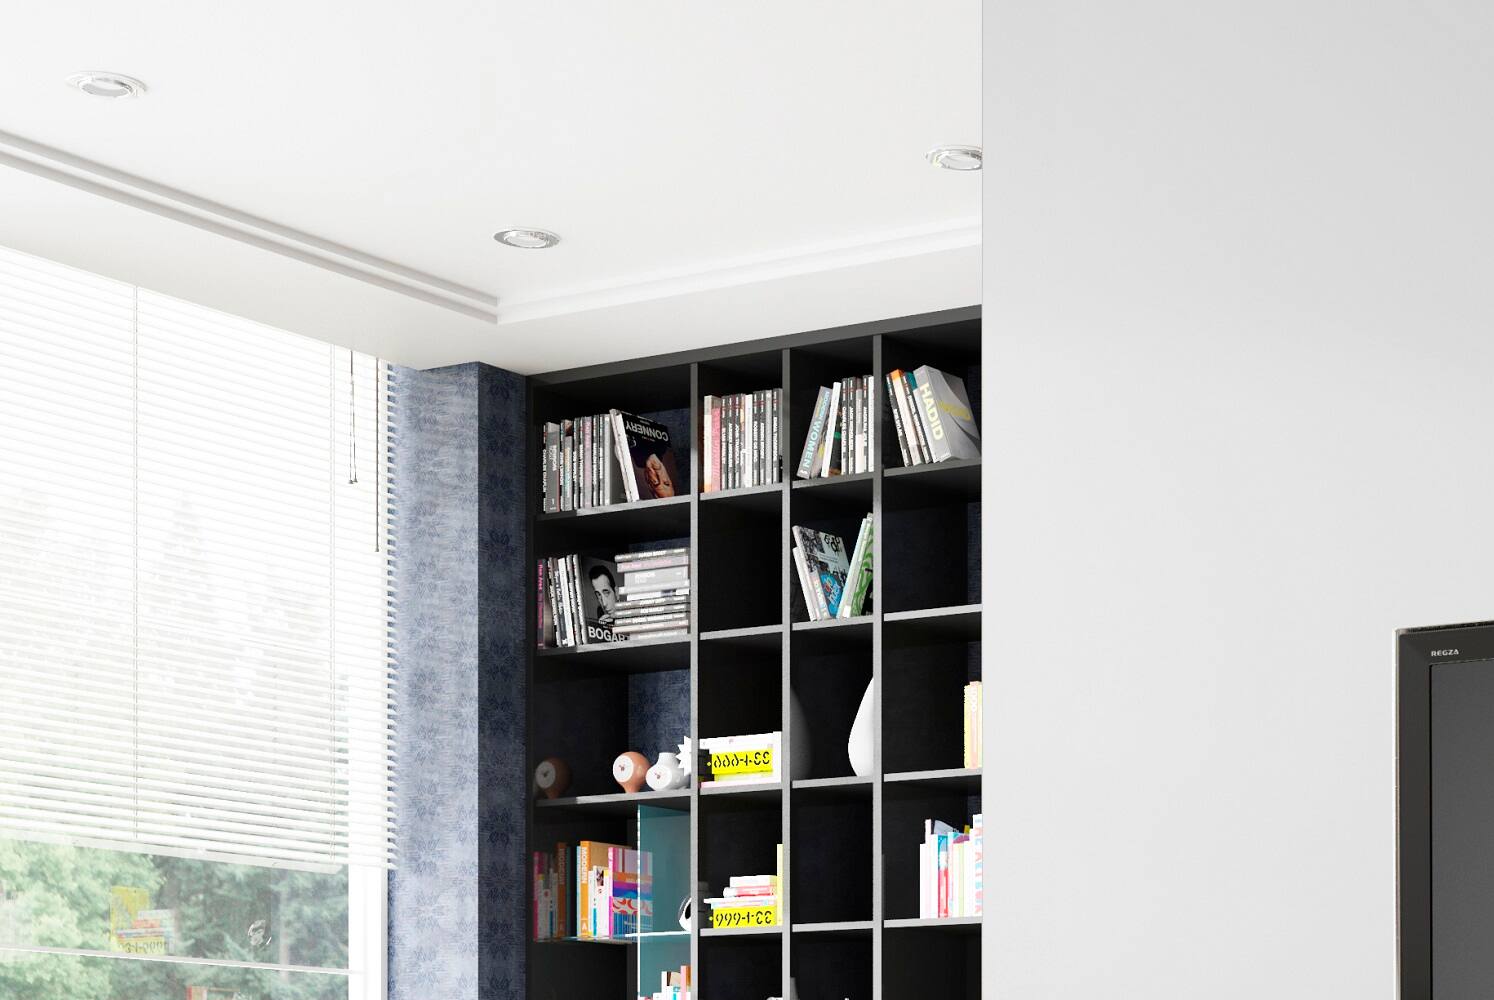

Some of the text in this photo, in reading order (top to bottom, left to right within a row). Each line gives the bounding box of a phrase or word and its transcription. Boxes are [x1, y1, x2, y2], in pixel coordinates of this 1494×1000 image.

[919, 382, 945, 441] HADID
[624, 420, 669, 442] CONNERY
[802, 421, 822, 469] WOMEN
[587, 625, 628, 642] BOGAR
[1430, 648, 1460, 657] REGZA
